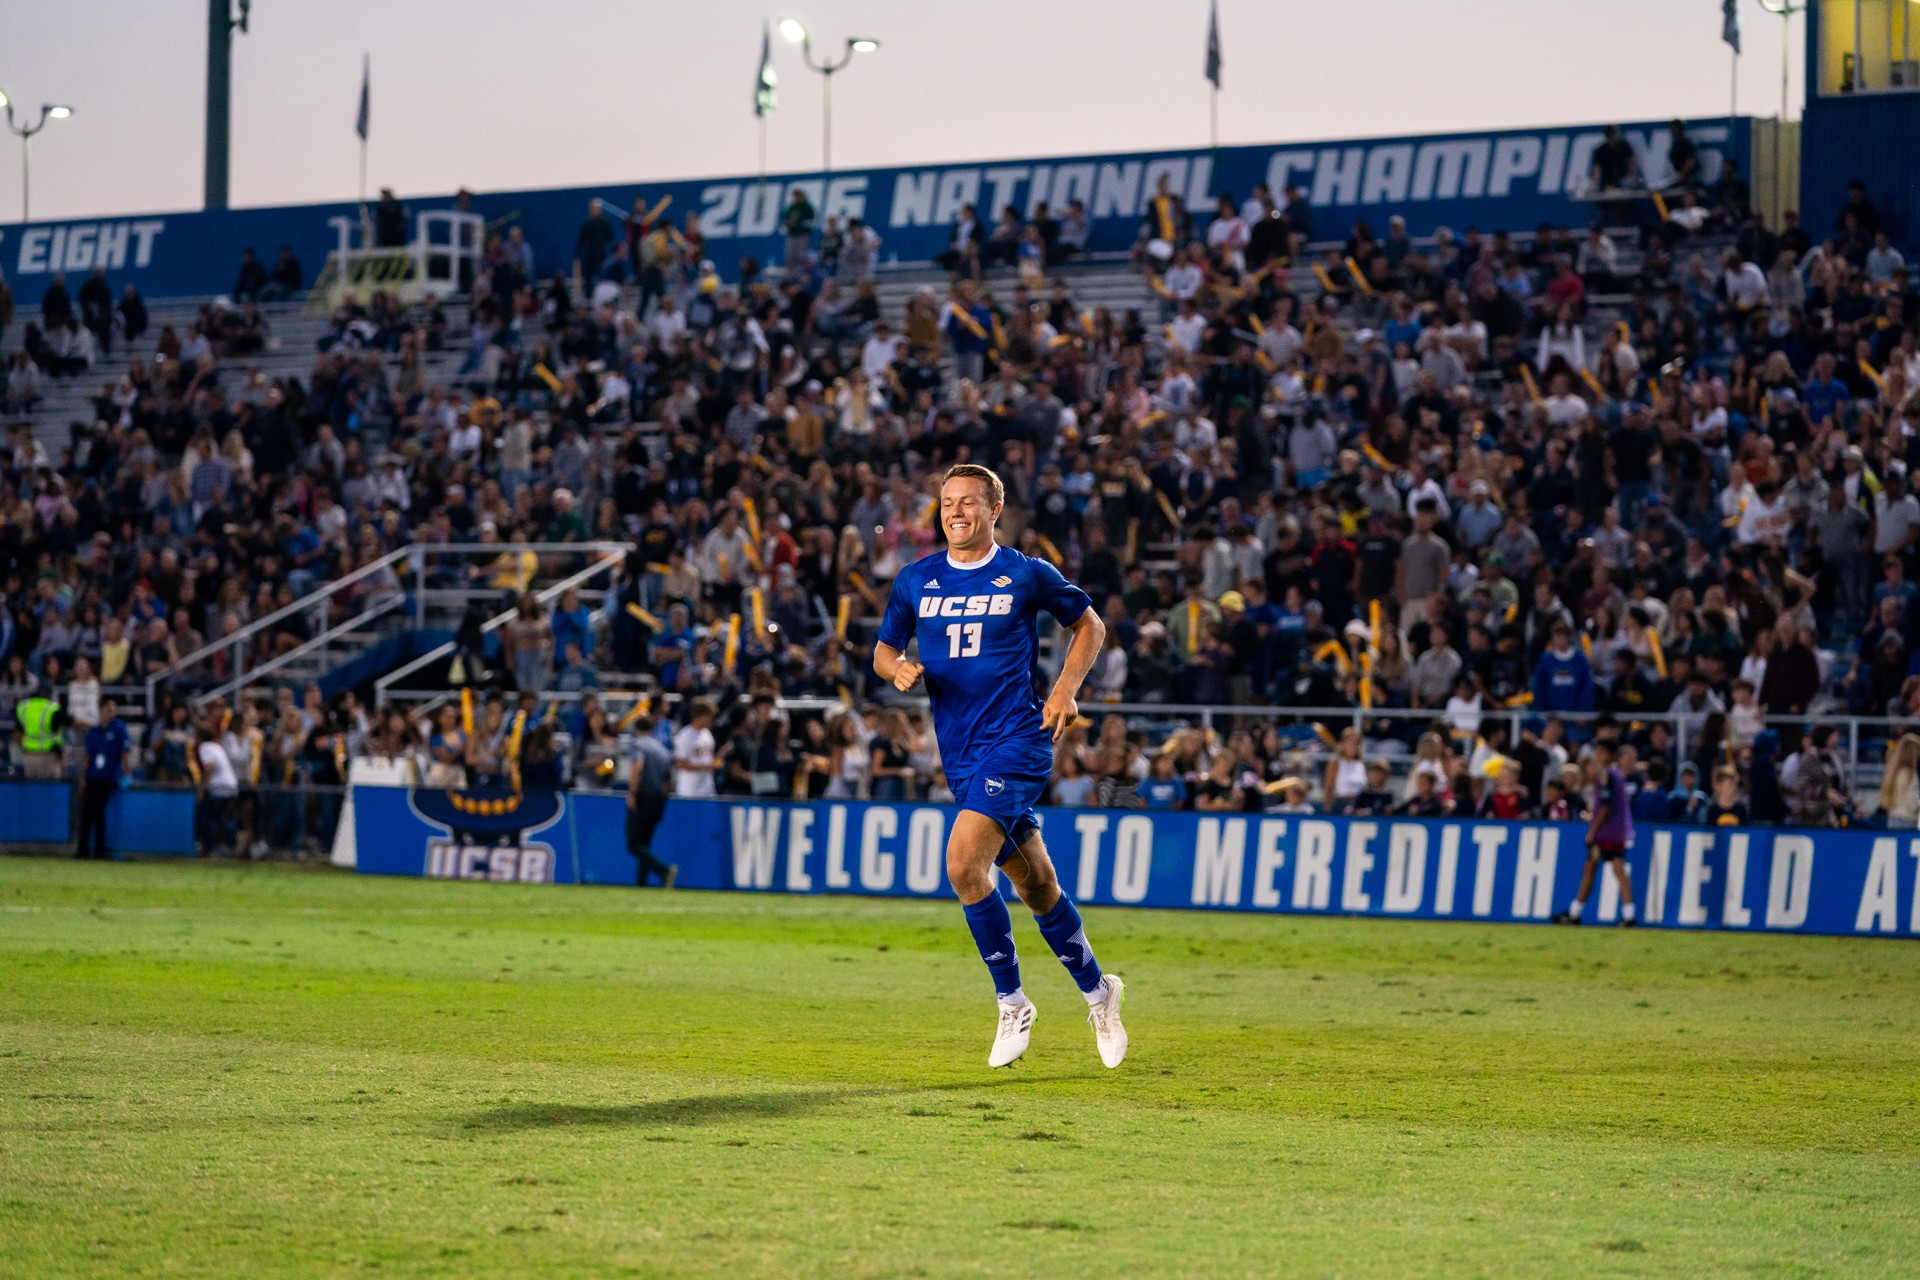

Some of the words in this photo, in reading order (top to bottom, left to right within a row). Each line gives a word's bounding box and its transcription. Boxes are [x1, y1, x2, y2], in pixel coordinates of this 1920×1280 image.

[889, 156, 1217, 227] NATIONAL
[17, 220, 165, 274] EIGHT
[919, 594, 1014, 618] UCSB
[946, 622, 983, 659] 13
[428, 844, 552, 883] UCSB
[730, 804, 1044, 898] WELCO
[1075, 814, 1153, 903] TO
[1190, 817, 1560, 918] MEREDITH
